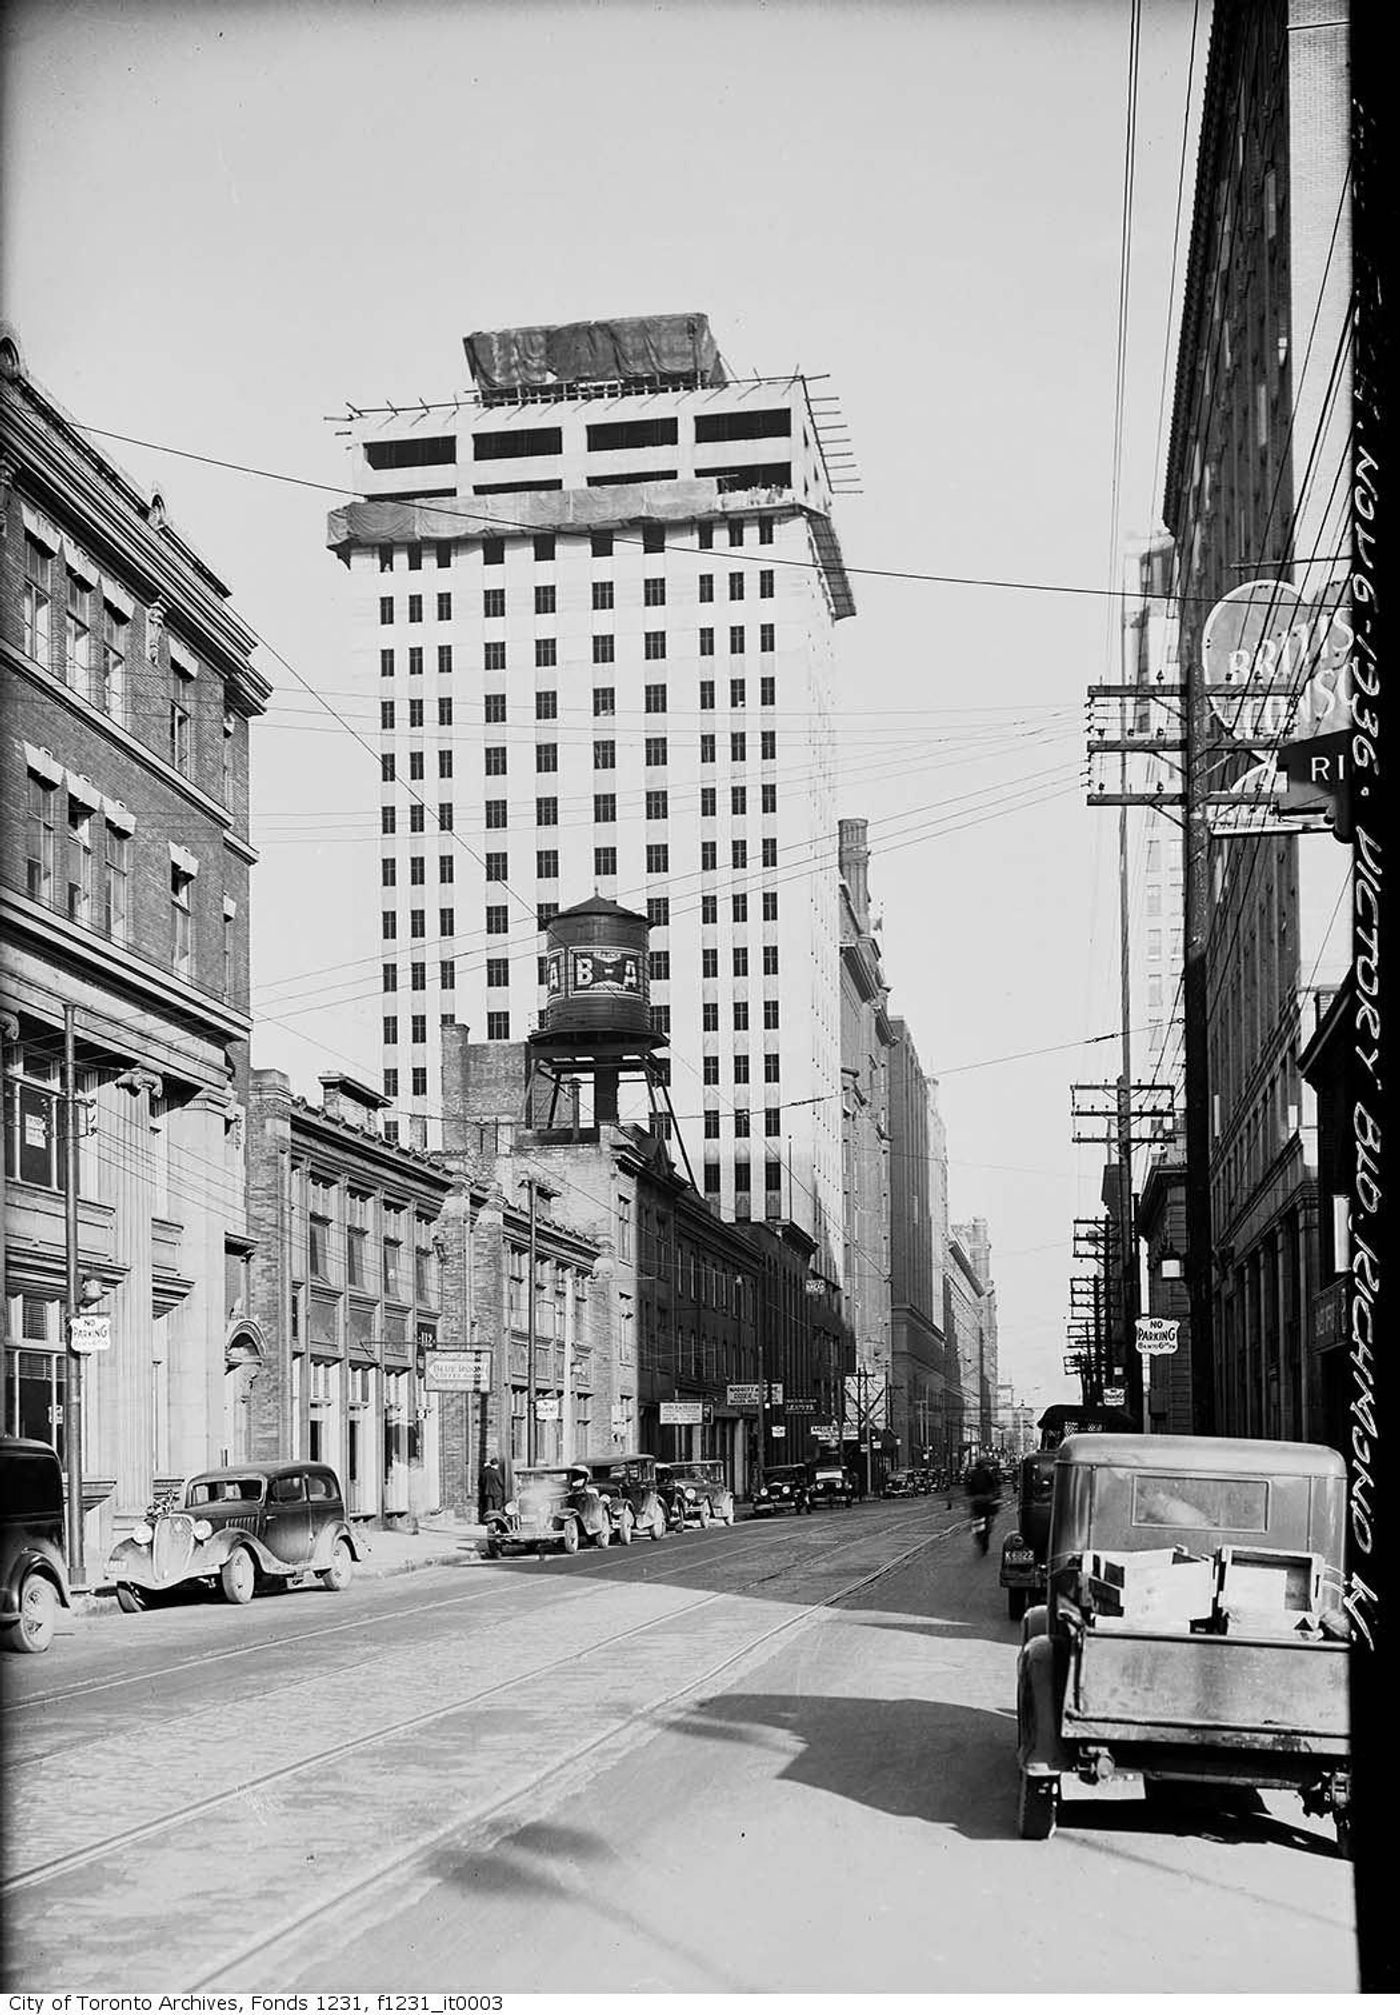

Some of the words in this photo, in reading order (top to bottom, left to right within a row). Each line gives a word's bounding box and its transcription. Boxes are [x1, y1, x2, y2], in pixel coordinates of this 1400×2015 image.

[1311, 755, 1345, 782] RI
[1150, 1320, 1163, 1328] NO
[1138, 1327, 1176, 1341] PARKING
